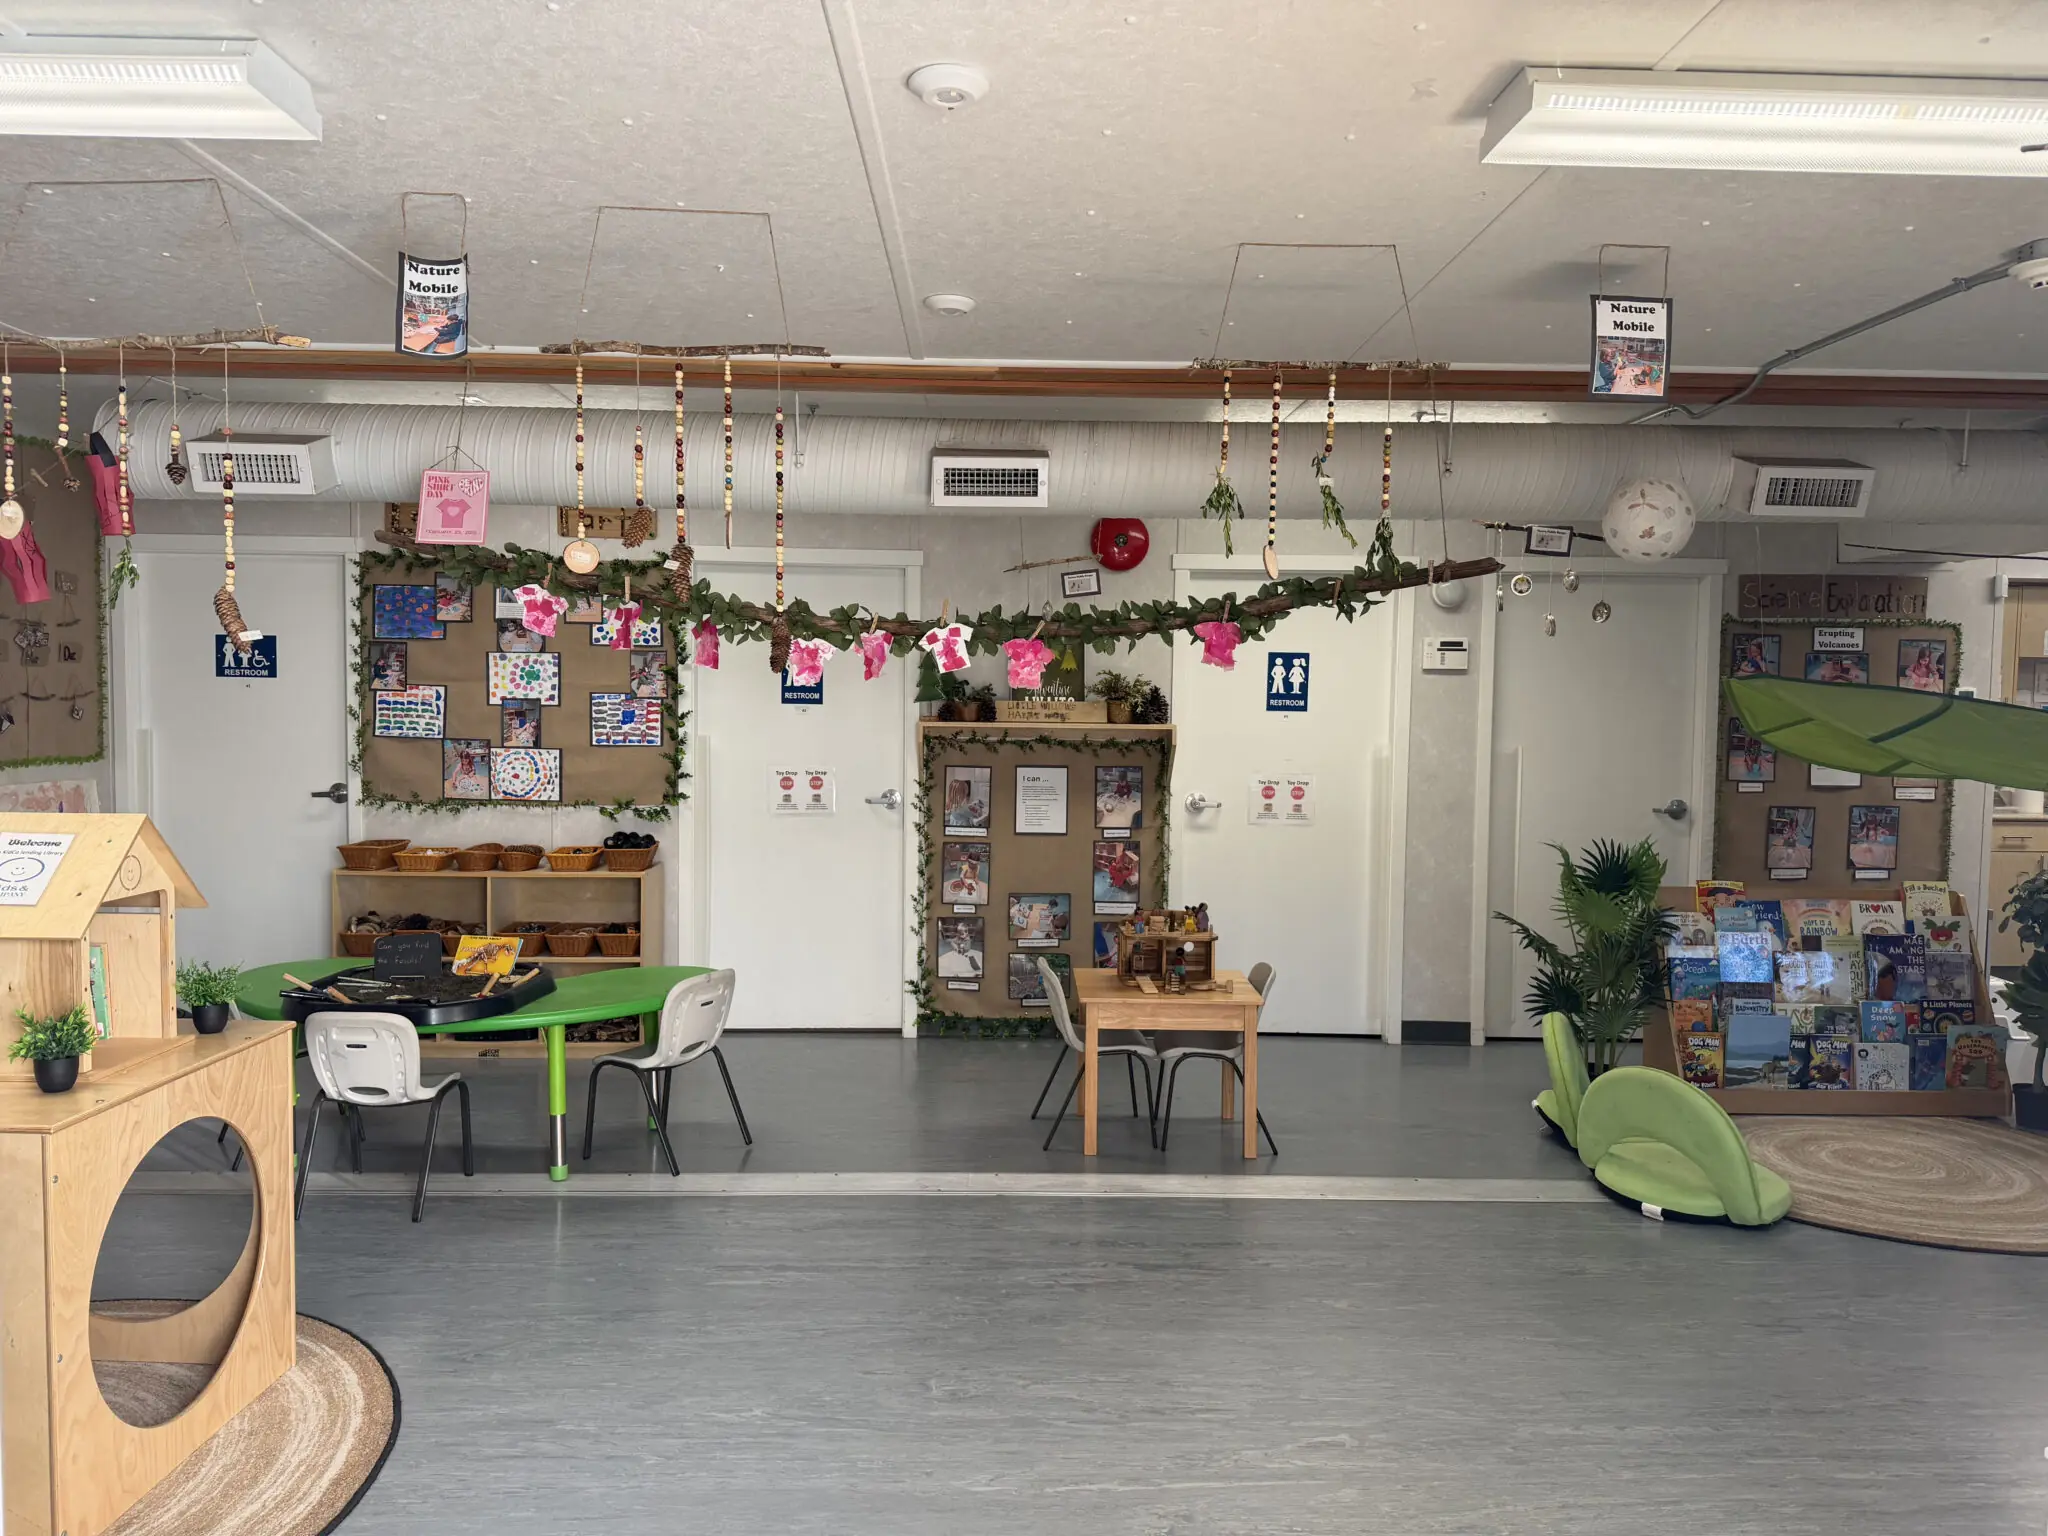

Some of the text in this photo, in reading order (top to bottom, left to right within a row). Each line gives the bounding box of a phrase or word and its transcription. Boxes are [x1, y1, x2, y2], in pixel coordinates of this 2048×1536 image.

[408, 261, 460, 275] Nature
[409, 280, 459, 293] Mobile
[1610, 303, 1656, 314] Nature
[1613, 320, 1655, 332] Mobile
[428, 476, 450, 484] PINK
[427, 483, 455, 491] SHIRT
[1743, 580, 1924, 616] Science Exploration
[1818, 630, 1855, 638] Erupting
[1818, 640, 1860, 649] Volcanoes
[224, 669, 269, 677] RESTROOM
[8, 839, 62, 847] Welcome
[1755, 911, 1782, 920] riends
[1800, 927, 1838, 936] RAINBOW
[1732, 934, 1769, 945] Earth
[1904, 937, 1924, 945] MAE
[1907, 956, 1924, 964] THE
[1682, 963, 1707, 974] Ocean
[1897, 965, 1925, 974] STARS
[1871, 1006, 1894, 1014] Deep
[1688, 1037, 1720, 1047] DOG MAN
[1791, 1040, 1806, 1048] MAN
[1816, 1040, 1848, 1049] DOG MAN
